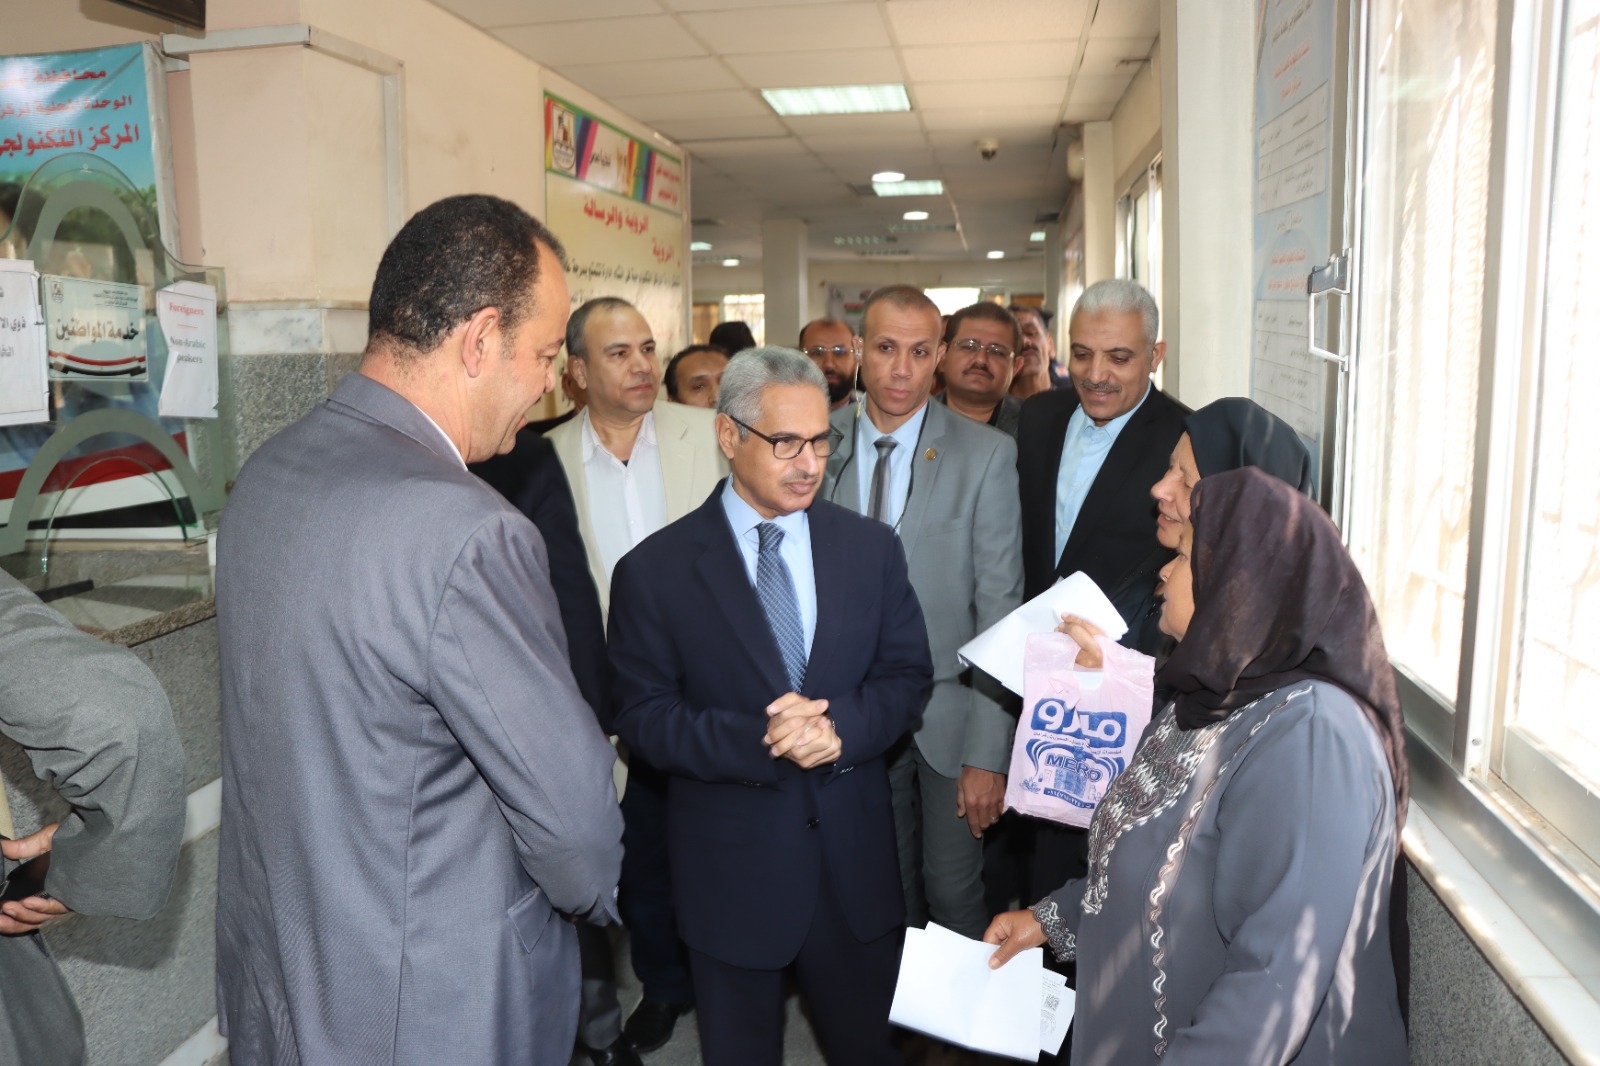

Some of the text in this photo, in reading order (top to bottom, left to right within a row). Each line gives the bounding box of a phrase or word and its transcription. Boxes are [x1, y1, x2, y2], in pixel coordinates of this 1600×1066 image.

[34, 68, 107, 82] محافظة
[84, 95, 132, 110] الوحدة
[88, 123, 139, 151] المركز
[169, 302, 205, 316] Foreigners
[56, 317, 139, 343] خدمة المواطنين
[1045, 753, 1103, 782] MERO
